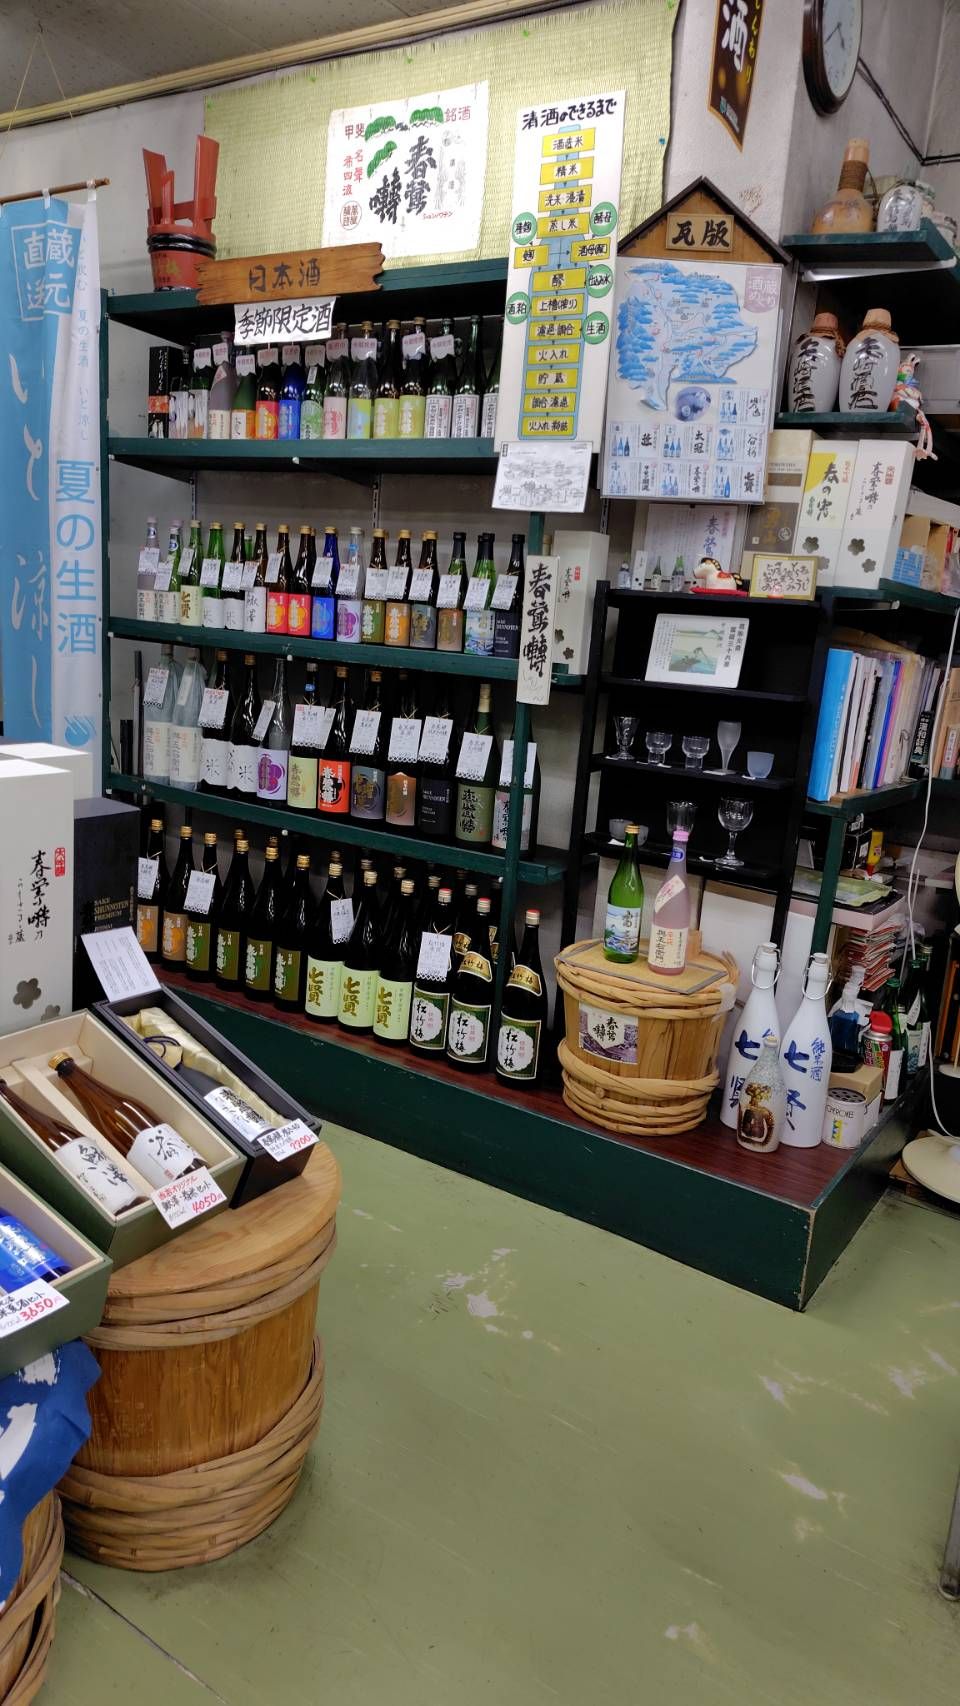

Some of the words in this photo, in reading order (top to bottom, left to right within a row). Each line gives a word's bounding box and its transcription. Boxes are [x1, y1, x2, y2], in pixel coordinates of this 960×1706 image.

[444, 105, 471, 122] 銘酒
[522, 98, 617, 131] 清酒のできるまで
[344, 122, 366, 140] 甲斐
[553, 135, 584, 151] 酒造米
[555, 163, 579, 178] 精米
[548, 217, 577, 233] 蒸し米
[671, 219, 730, 248] 瓦版
[24, 231, 46, 311] 直送
[45, 228, 75, 308] 蔵元
[249, 258, 321, 292] 日本酒
[238, 303, 331, 340] 季節限定酒
[507, 303, 528, 316] 酒粕
[585, 321, 608, 337] 生酒
[538, 349, 569, 362] 火入れ
[55, 459, 97, 655] 夏の生酒
[308, 967, 324, 1007] 七賢
[342, 977, 360, 1017] 七賢
[376, 987, 393, 1028] 七賢
[413, 1001, 427, 1039] 松竹梅
[455, 1015, 469, 1052] 松竹梅
[503, 1030, 518, 1069] 松竹梅
